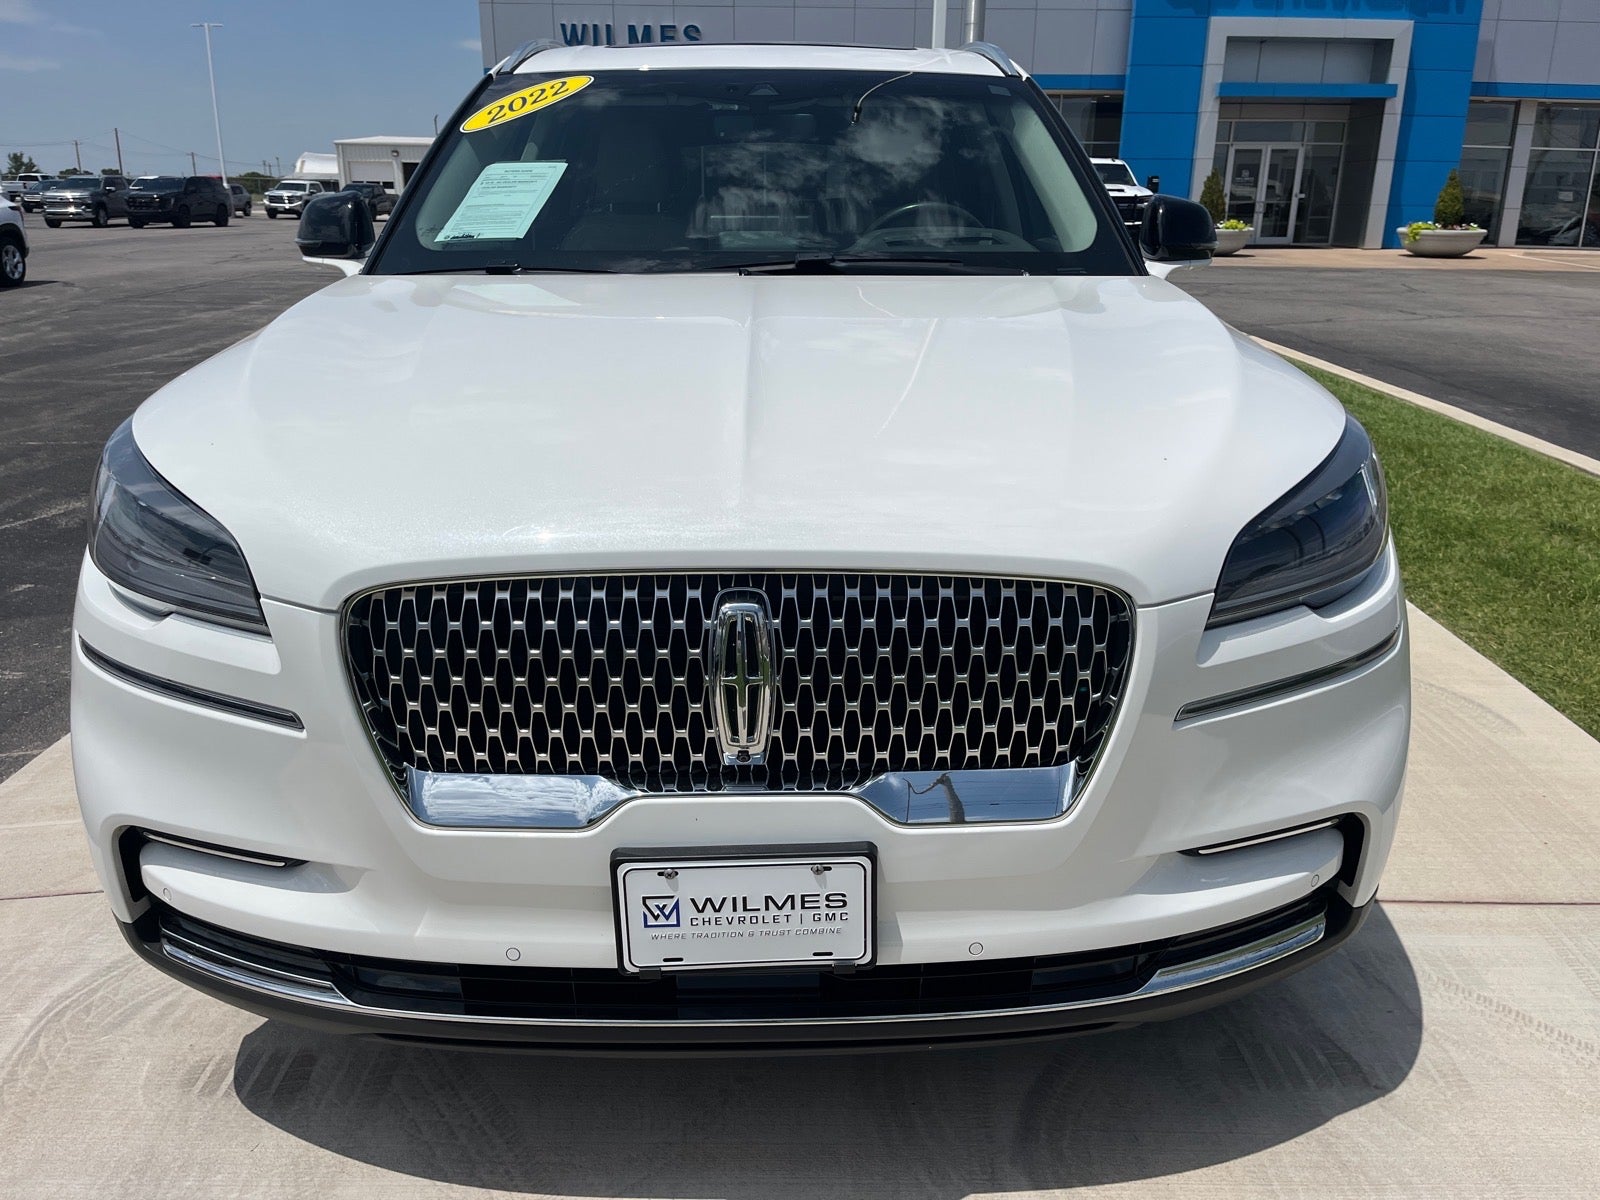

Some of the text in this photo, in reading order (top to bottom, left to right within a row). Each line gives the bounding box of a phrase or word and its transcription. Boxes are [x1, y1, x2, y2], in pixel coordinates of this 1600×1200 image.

[560, 23, 702, 46] WILMES
[487, 81, 569, 124] 2022
[689, 892, 848, 914] WILMES
[690, 914, 792, 927] CHEVROLET
[812, 912, 849, 923] GMC
[651, 932, 687, 940] WHERE
[691, 931, 744, 939] TRADITION
[759, 929, 791, 937] TRUST
[795, 927, 842, 936] COMBINE
